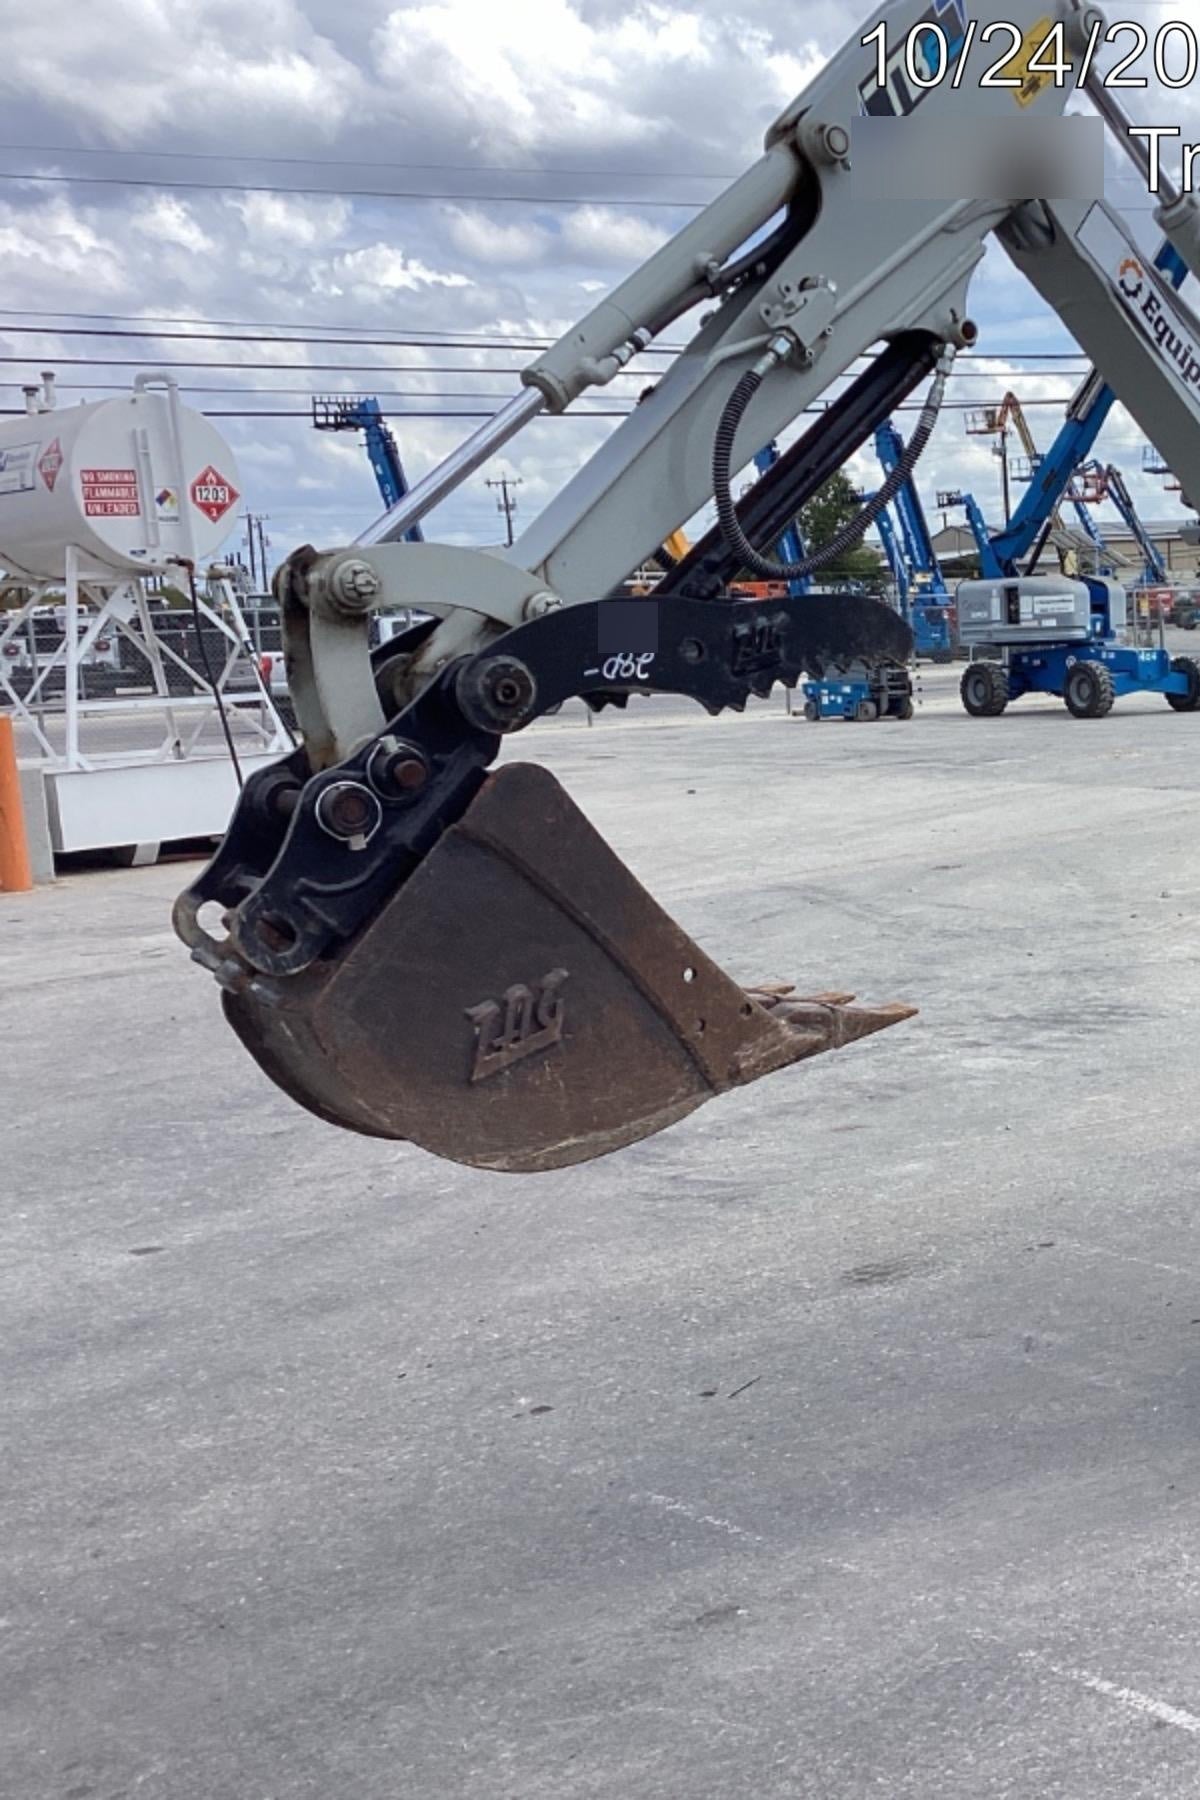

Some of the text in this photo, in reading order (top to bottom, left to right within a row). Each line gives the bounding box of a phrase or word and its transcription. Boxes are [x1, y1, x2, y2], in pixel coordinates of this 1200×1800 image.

[96, 471, 135, 482] SMOKING
[84, 486, 137, 498] FLAMMABLE
[197, 487, 227, 500] 1203
[87, 502, 137, 514] UNLEADED
